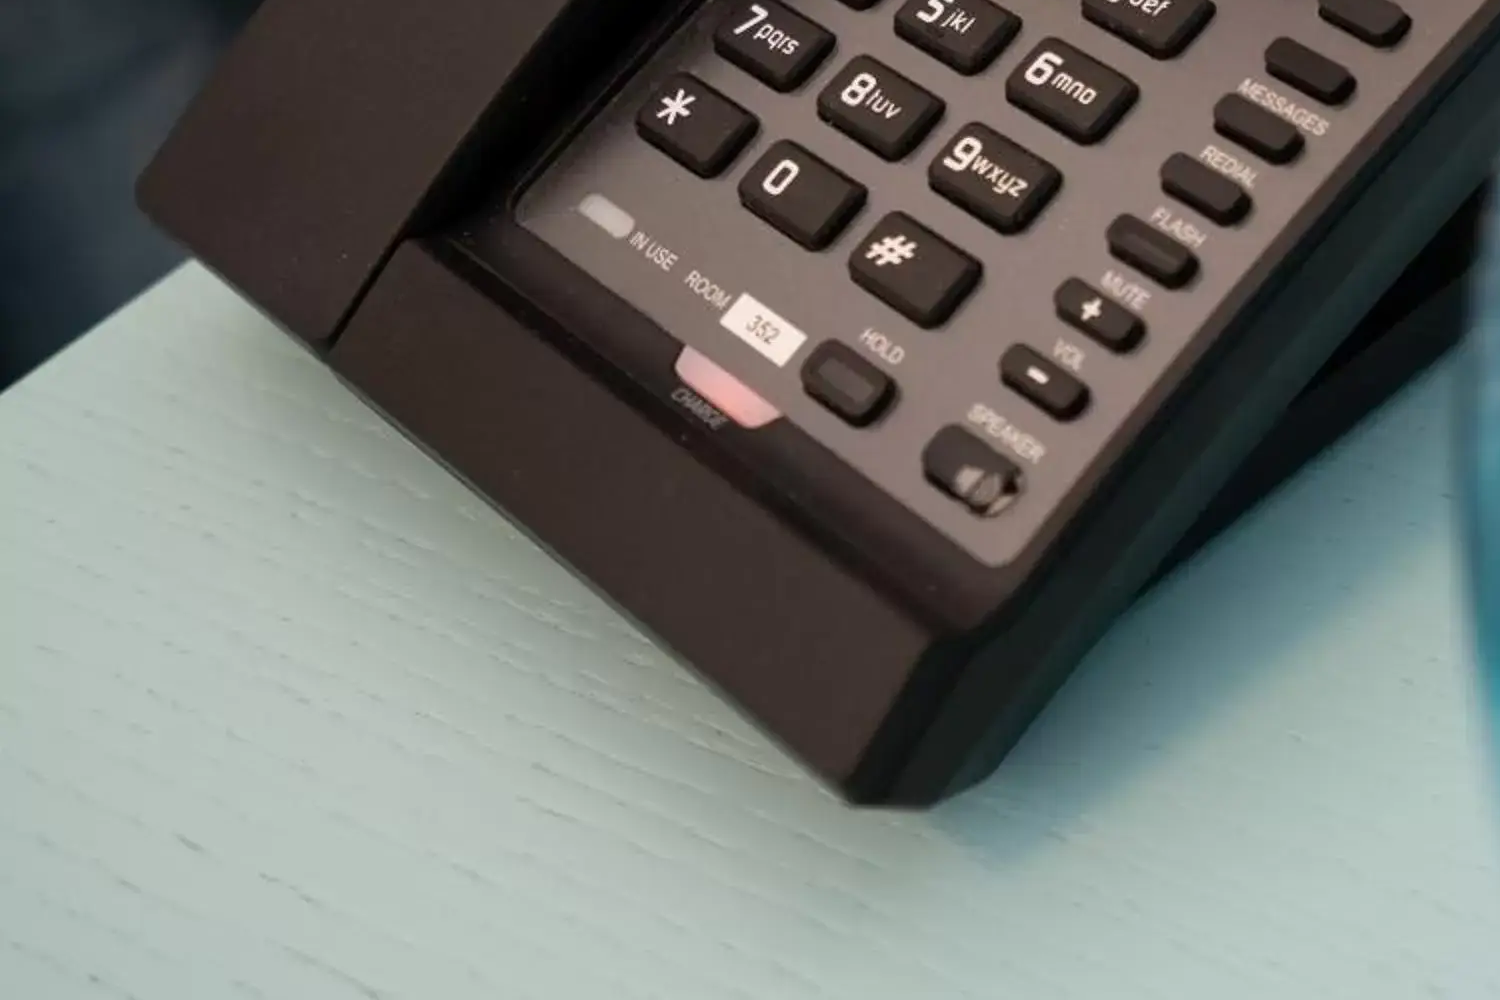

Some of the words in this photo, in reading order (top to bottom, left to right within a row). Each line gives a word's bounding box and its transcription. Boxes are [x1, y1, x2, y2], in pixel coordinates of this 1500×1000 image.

[1237, 77, 1331, 137] MESSAGES
[762, 158, 799, 195] 0
[1199, 145, 1259, 188] REDIAL
[1150, 207, 1207, 248] FLASH
[628, 231, 650, 251] IN
[644, 245, 680, 272] USE
[865, 234, 918, 266] #
[684, 270, 733, 310] ROOM
[1100, 270, 1152, 310] MUTE
[746, 314, 781, 345] 352
[858, 327, 905, 365] HOLD
[1053, 337, 1086, 371] VOL
[966, 403, 1046, 464] SPEAKER
